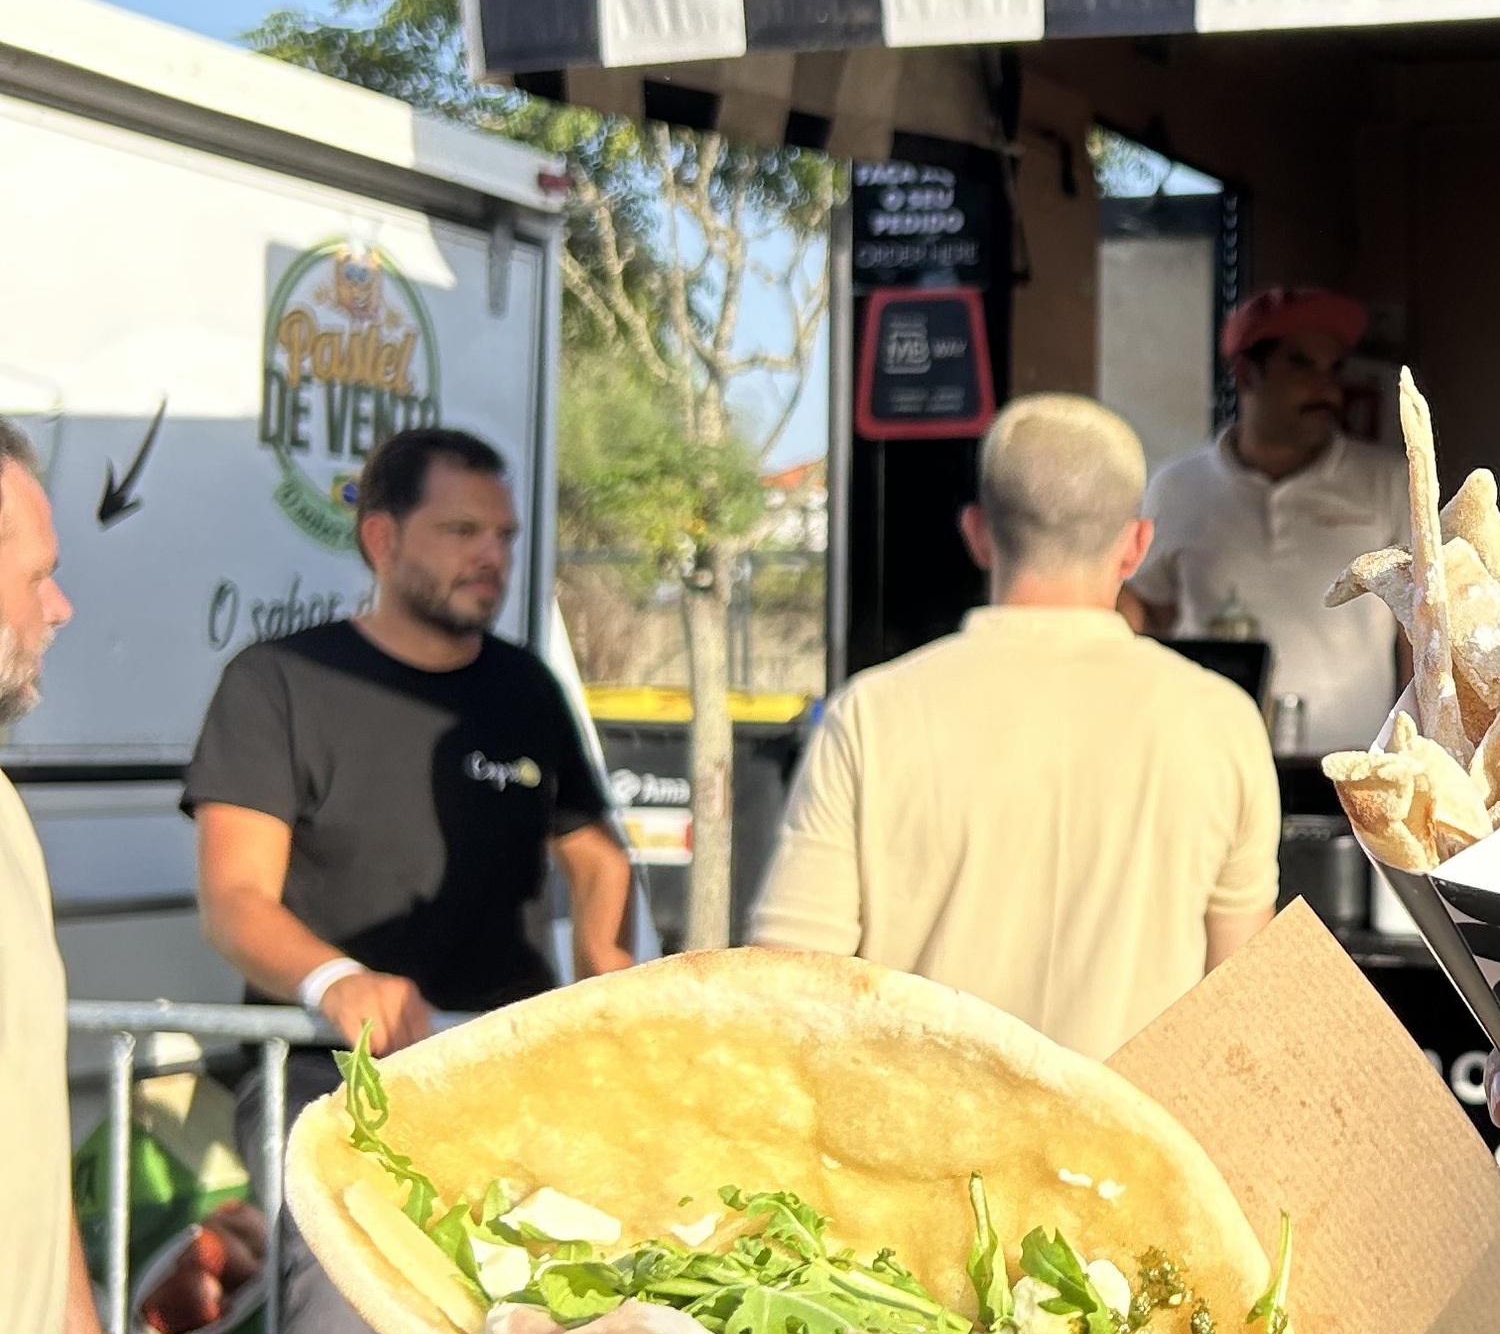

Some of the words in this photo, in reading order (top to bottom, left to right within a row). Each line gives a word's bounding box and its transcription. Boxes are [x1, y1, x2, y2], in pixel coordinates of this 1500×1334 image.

[275, 307, 420, 396] Pastel
[261, 366, 312, 449] DE
[208, 576, 239, 652] O
